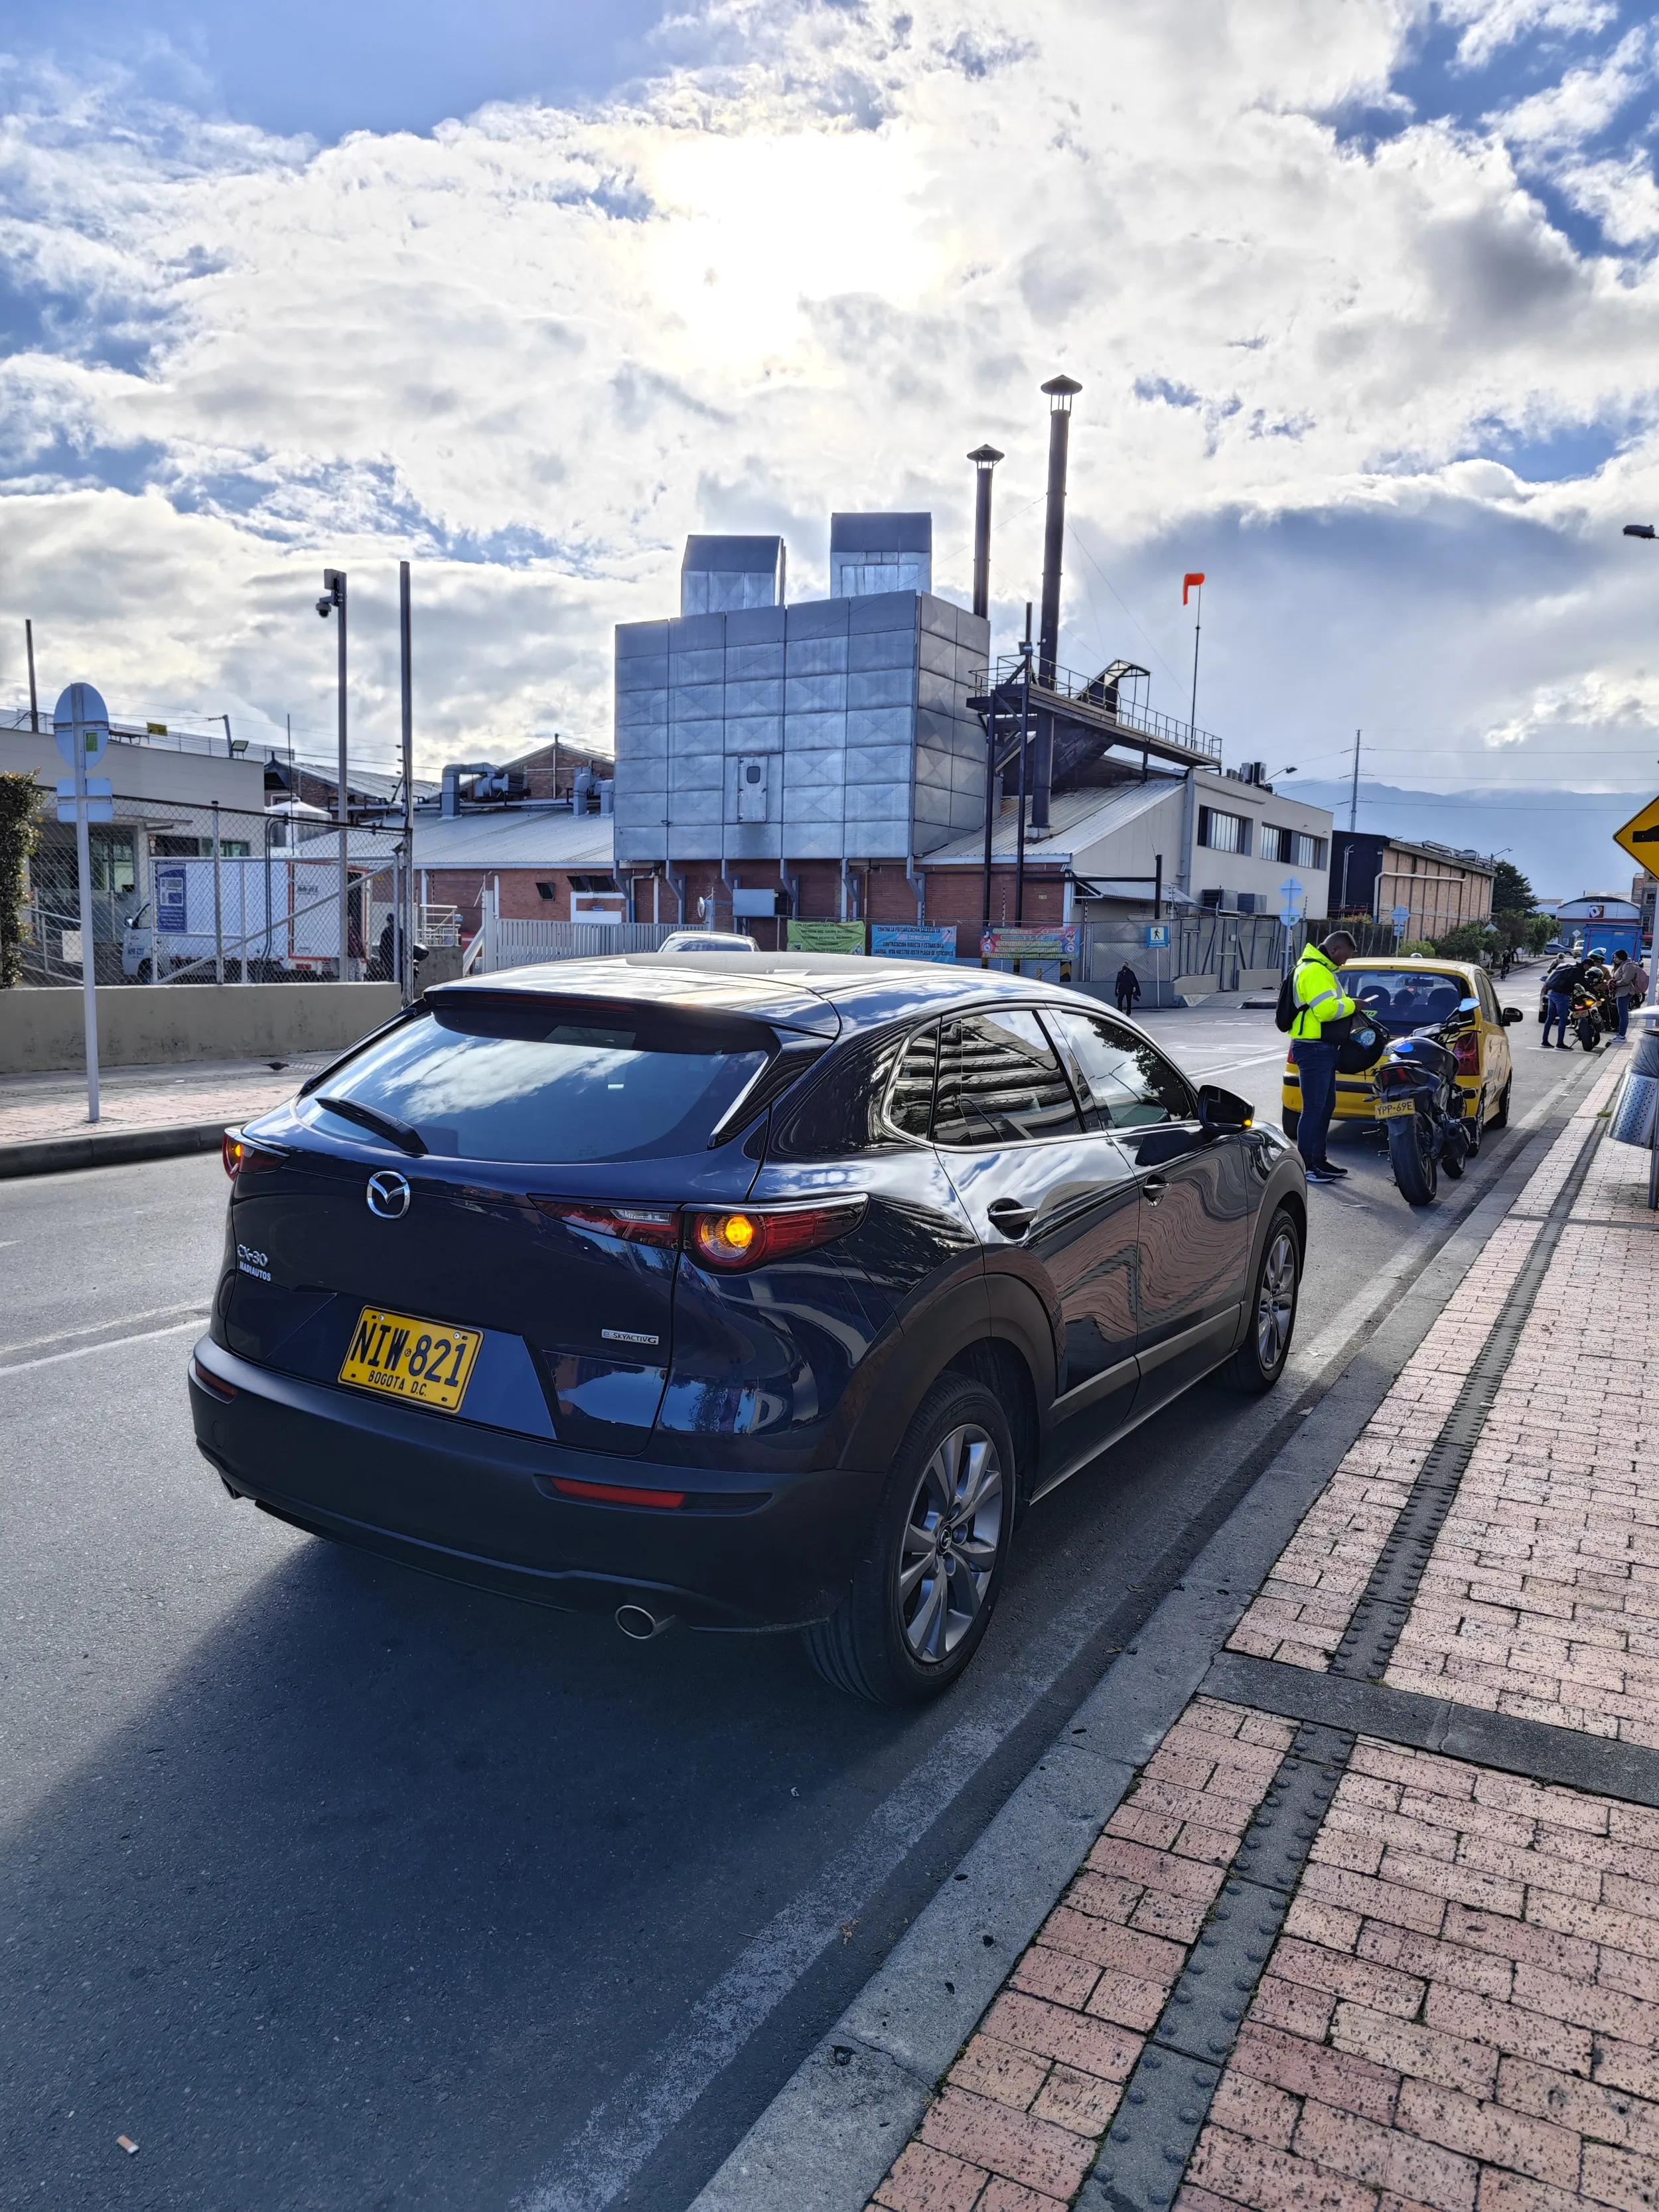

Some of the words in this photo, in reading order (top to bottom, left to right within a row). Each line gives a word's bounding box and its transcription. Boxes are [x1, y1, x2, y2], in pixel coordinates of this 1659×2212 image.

[237, 1244, 268, 1267] CX-30
[240, 1260, 271, 1282] MADIAUTOS
[350, 1320, 410, 1371] NIW
[408, 1335, 467, 1387] 821
[368, 1370, 406, 1391] BOGOTA
[411, 1381, 427, 1396] D.C.
